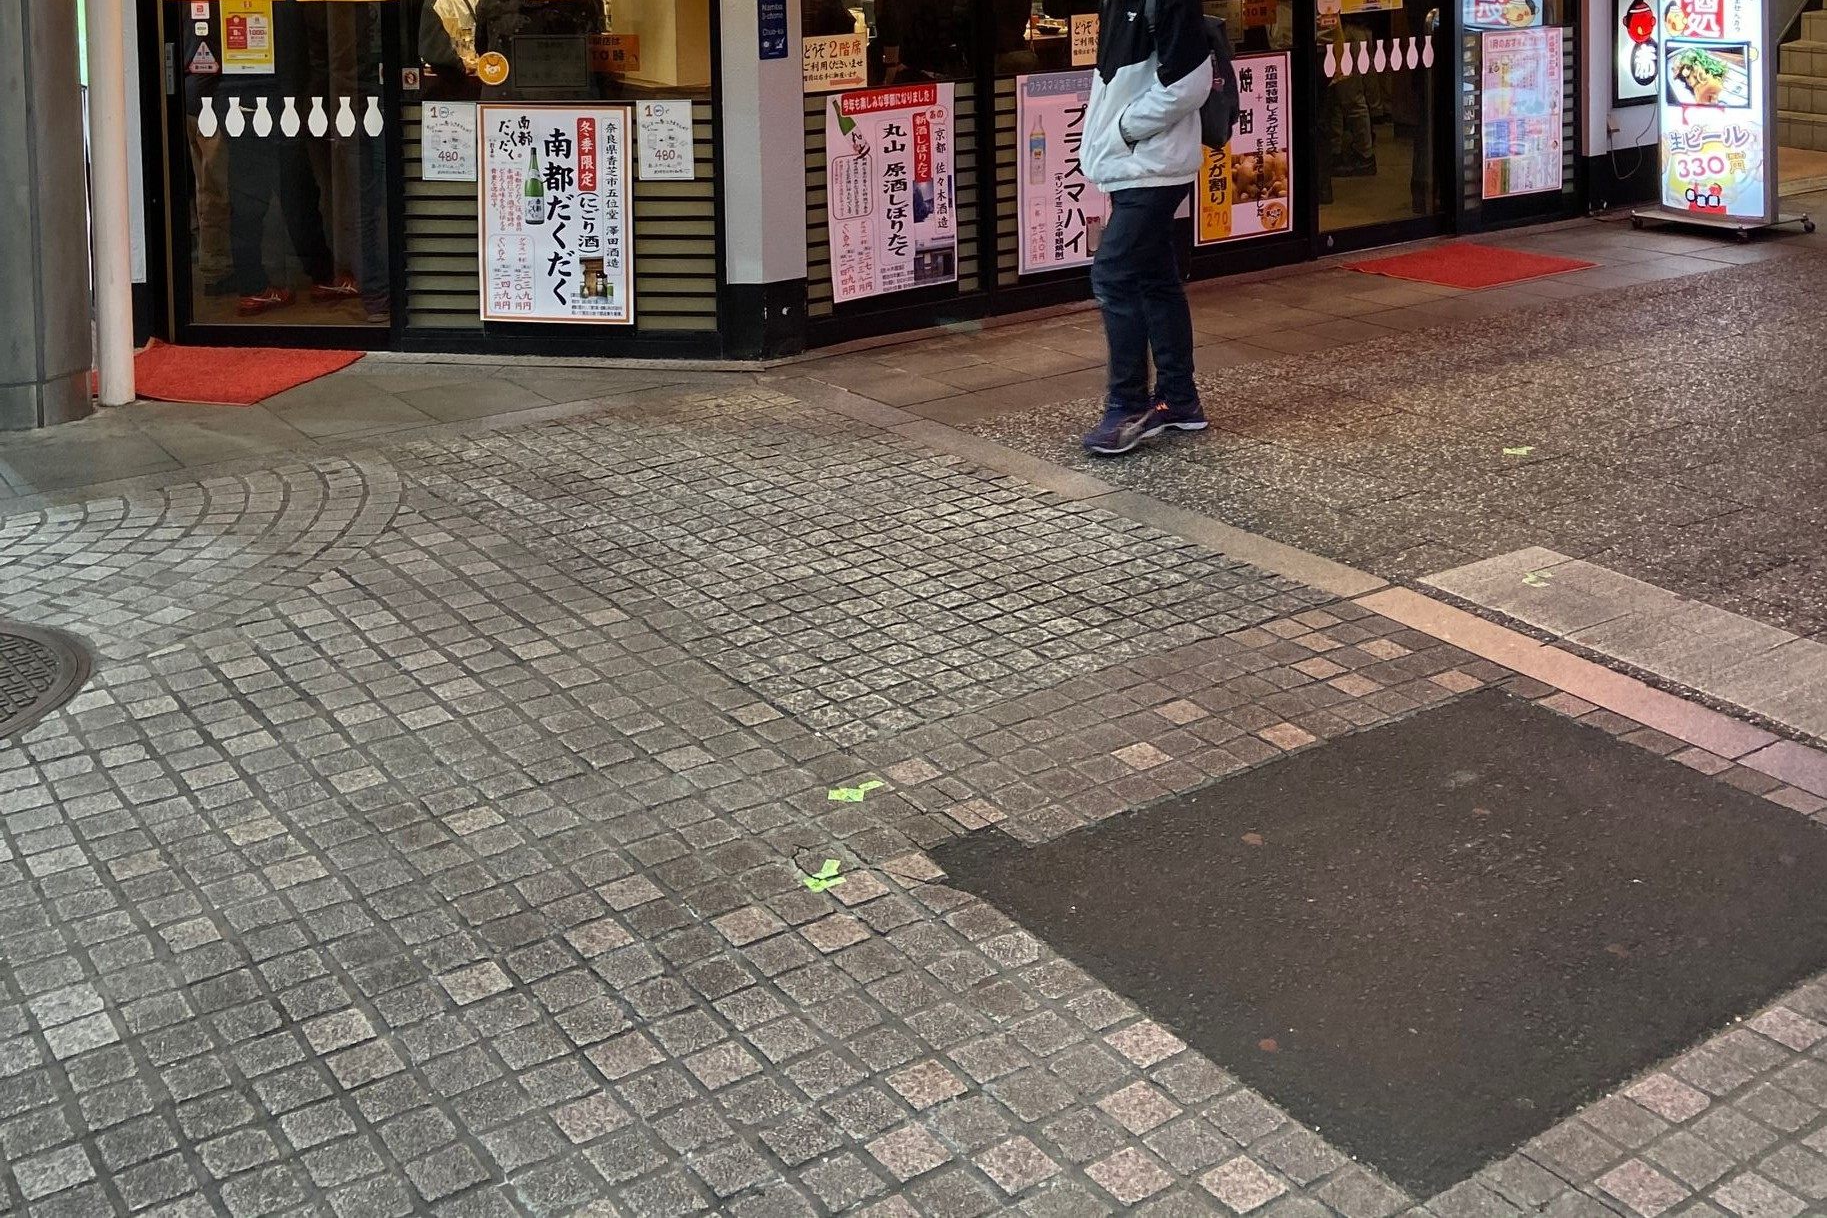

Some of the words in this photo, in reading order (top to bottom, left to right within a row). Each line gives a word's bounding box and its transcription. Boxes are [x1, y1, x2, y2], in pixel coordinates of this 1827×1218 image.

[579, 120, 596, 187] 冬季限定
[883, 123, 908, 154] 丸山
[934, 128, 947, 153] 京都
[1671, 125, 1749, 152] 生ビール
[1677, 156, 1725, 178] 330
[605, 122, 619, 220] 奈良県香芝市五位堂
[935, 161, 949, 229] 佐々木酒造
[1208, 148, 1228, 205] うが割り
[543, 127, 575, 306] 南都だくだく
[883, 161, 909, 257] 原酒しぼりたて
